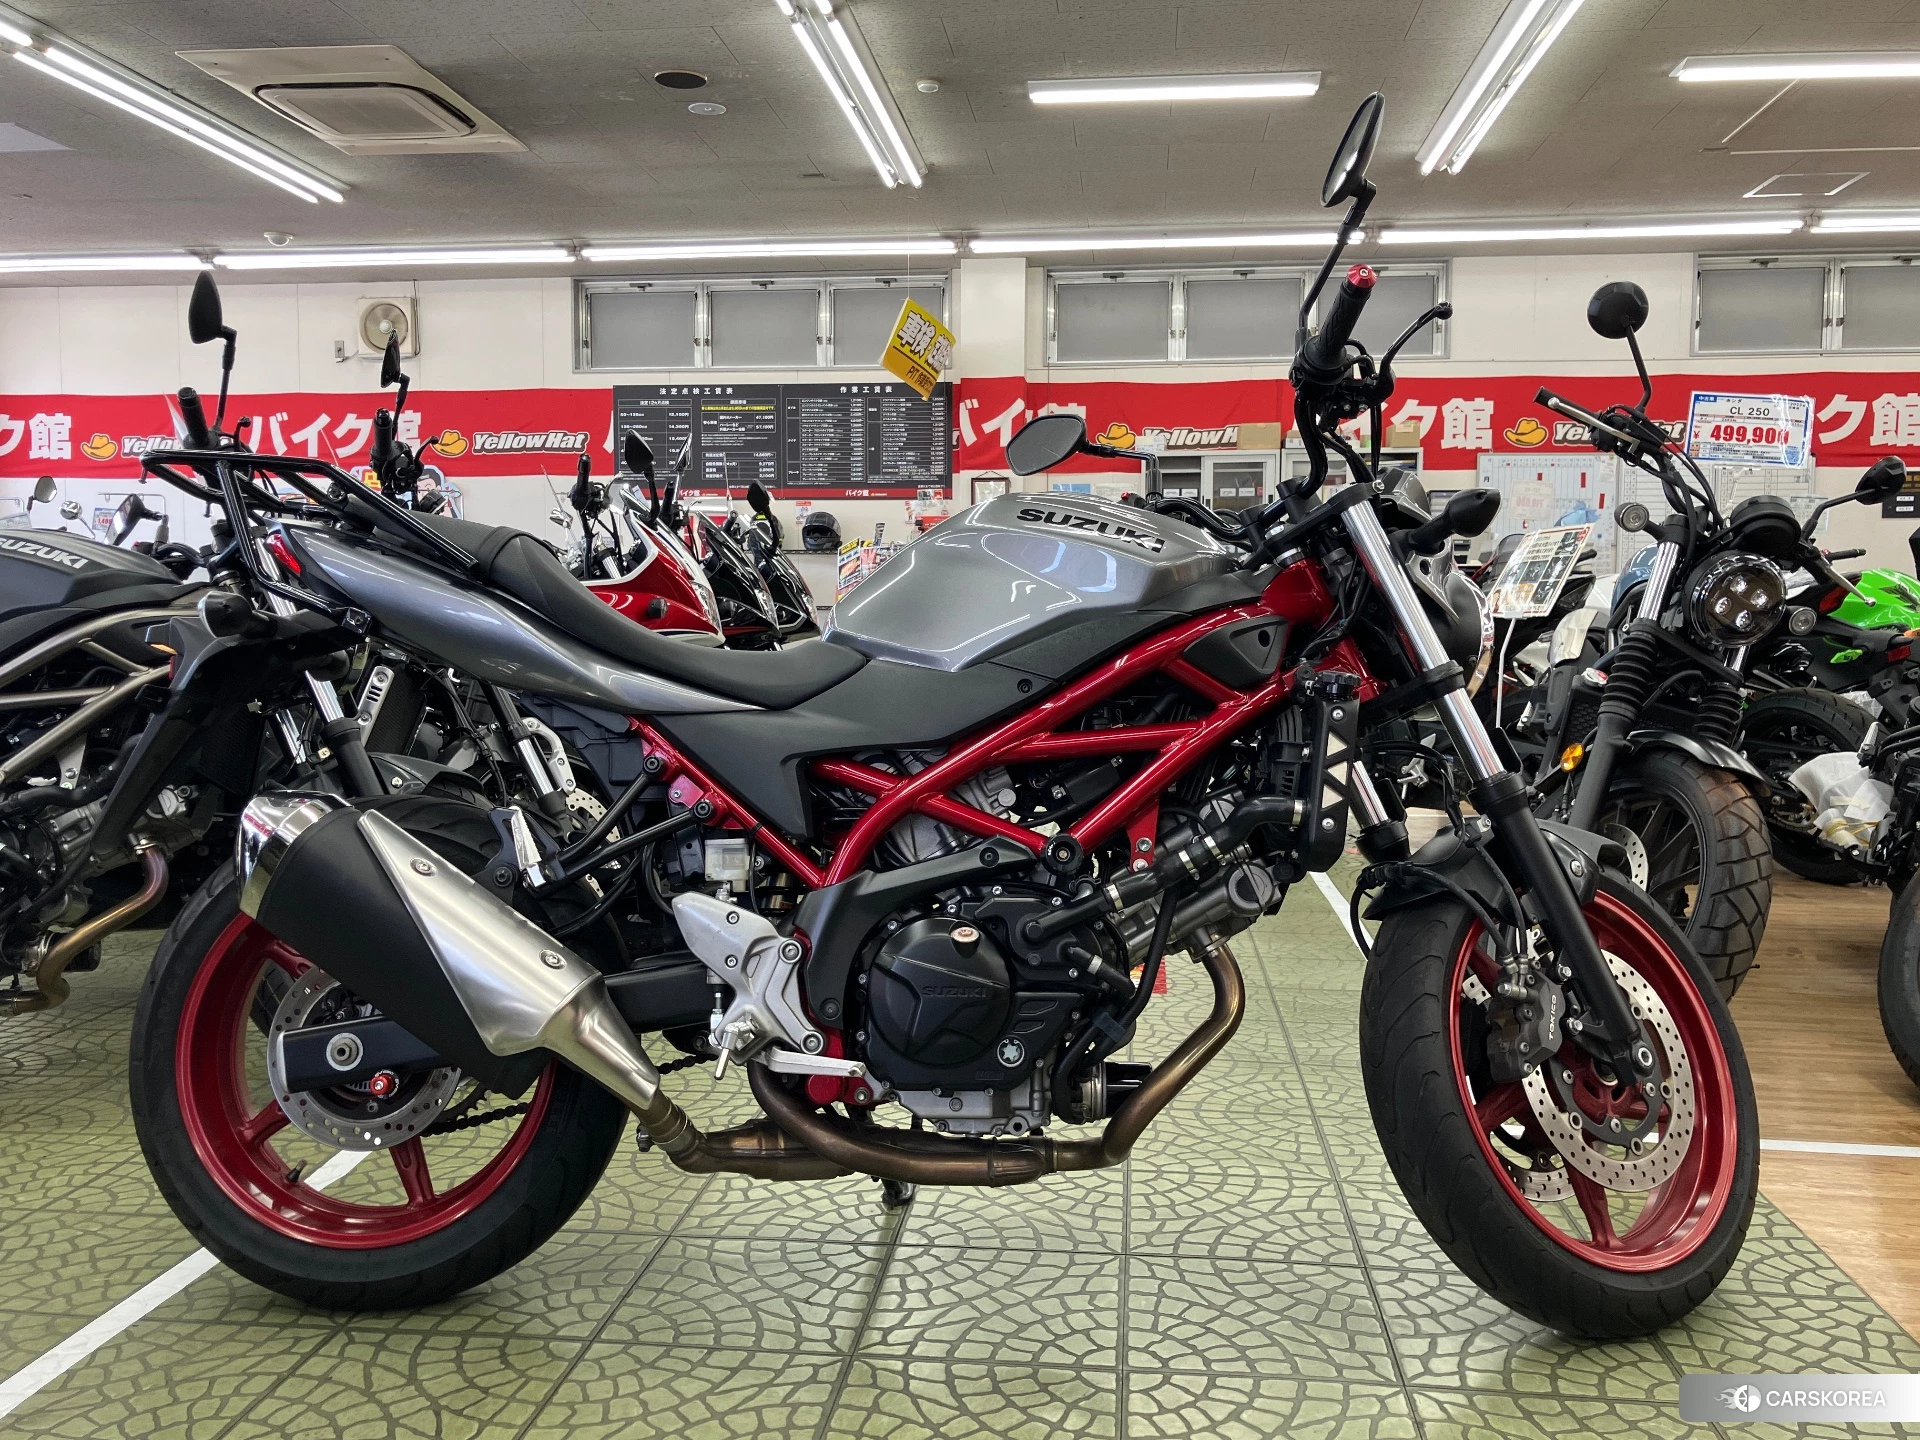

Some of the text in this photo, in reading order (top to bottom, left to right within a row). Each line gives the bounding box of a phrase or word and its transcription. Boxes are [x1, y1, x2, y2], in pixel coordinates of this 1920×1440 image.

[1730, 406, 1770, 417] CL 250
[959, 398, 1087, 447] バイ
[1710, 424, 1790, 445] 499,900
[845, 489, 869, 497] バイク館
[1016, 508, 1166, 554] SUZUKI
[921, 985, 987, 998] SUZUKI
[1548, 994, 1557, 1041] TOKICO
